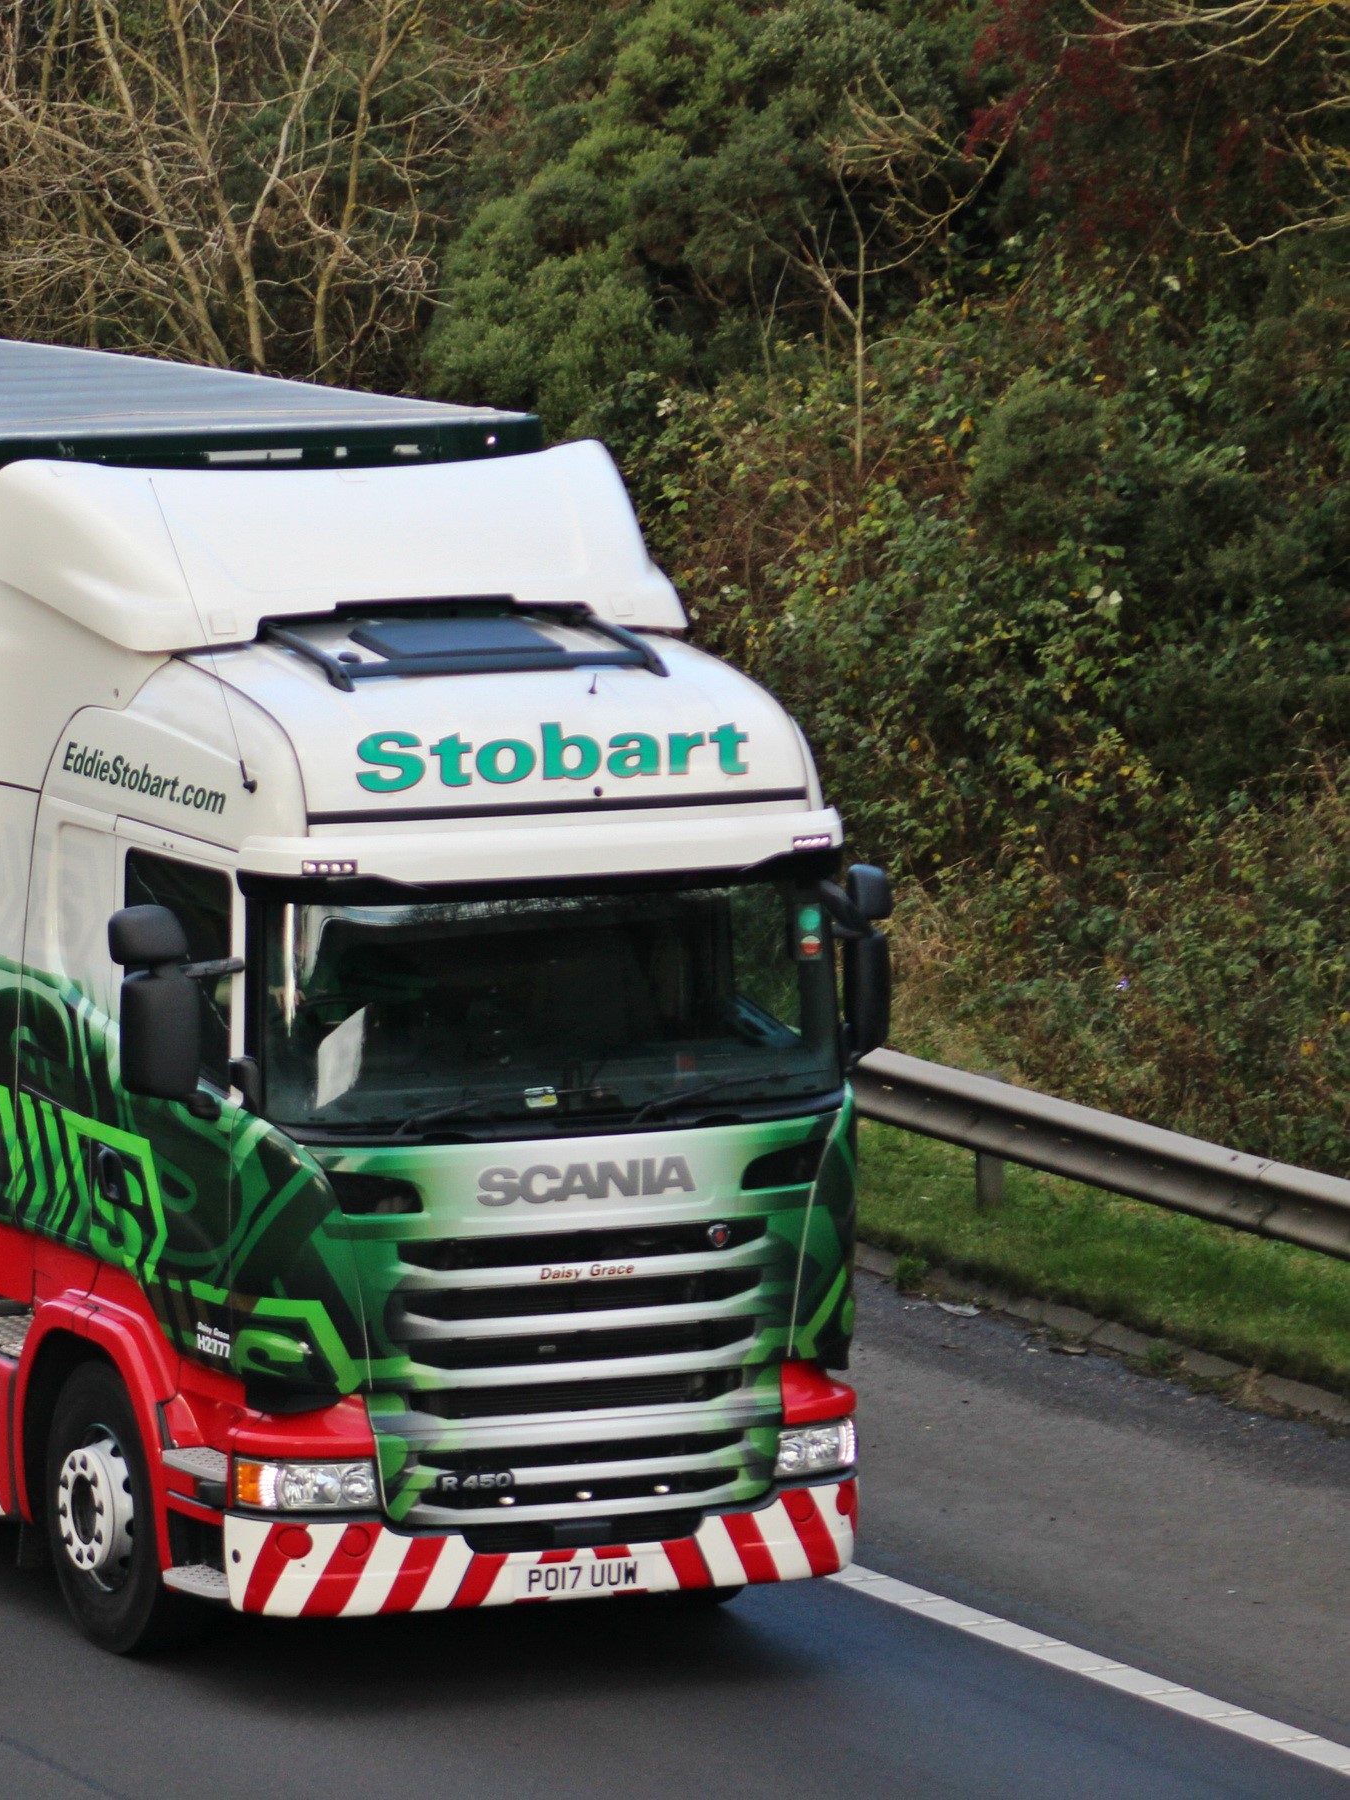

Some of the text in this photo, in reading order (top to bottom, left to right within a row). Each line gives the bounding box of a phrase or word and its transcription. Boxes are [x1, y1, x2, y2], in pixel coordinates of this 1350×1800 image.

[62, 741, 226, 814] EddieStobart.com
[355, 721, 750, 793] Stobart
[476, 1155, 697, 1207] SCANIA
[540, 1264, 635, 1280] Daisy Grace
[442, 1472, 512, 1492] R 450
[528, 1561, 638, 1593] PO17 UUW
